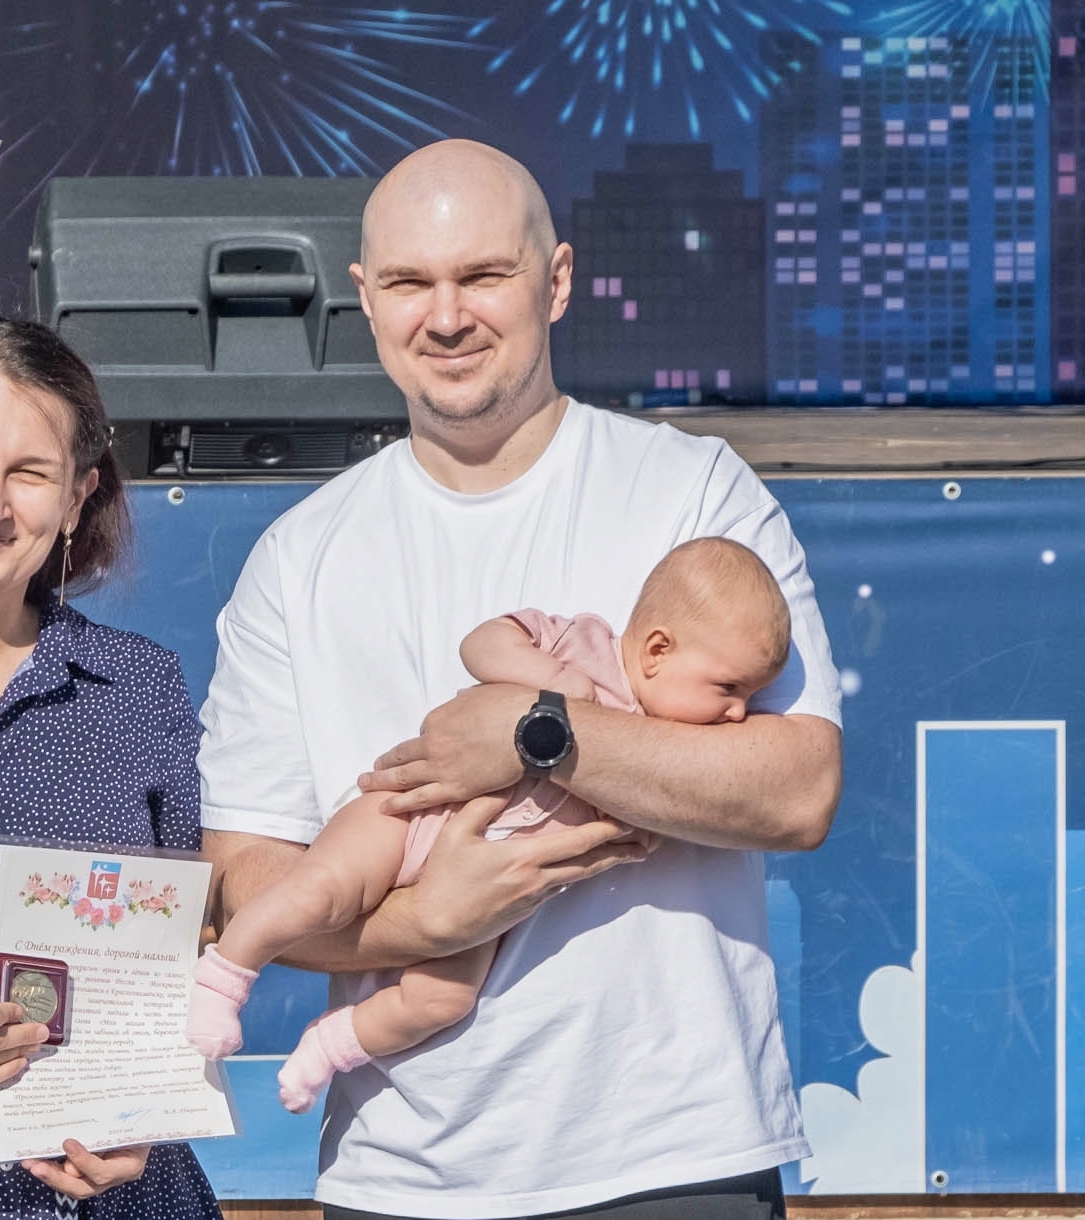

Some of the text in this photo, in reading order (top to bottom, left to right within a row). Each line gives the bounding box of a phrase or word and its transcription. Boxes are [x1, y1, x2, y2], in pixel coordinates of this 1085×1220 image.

[14, 940, 180, 963] С Днём рождения, дорогой малыш!
